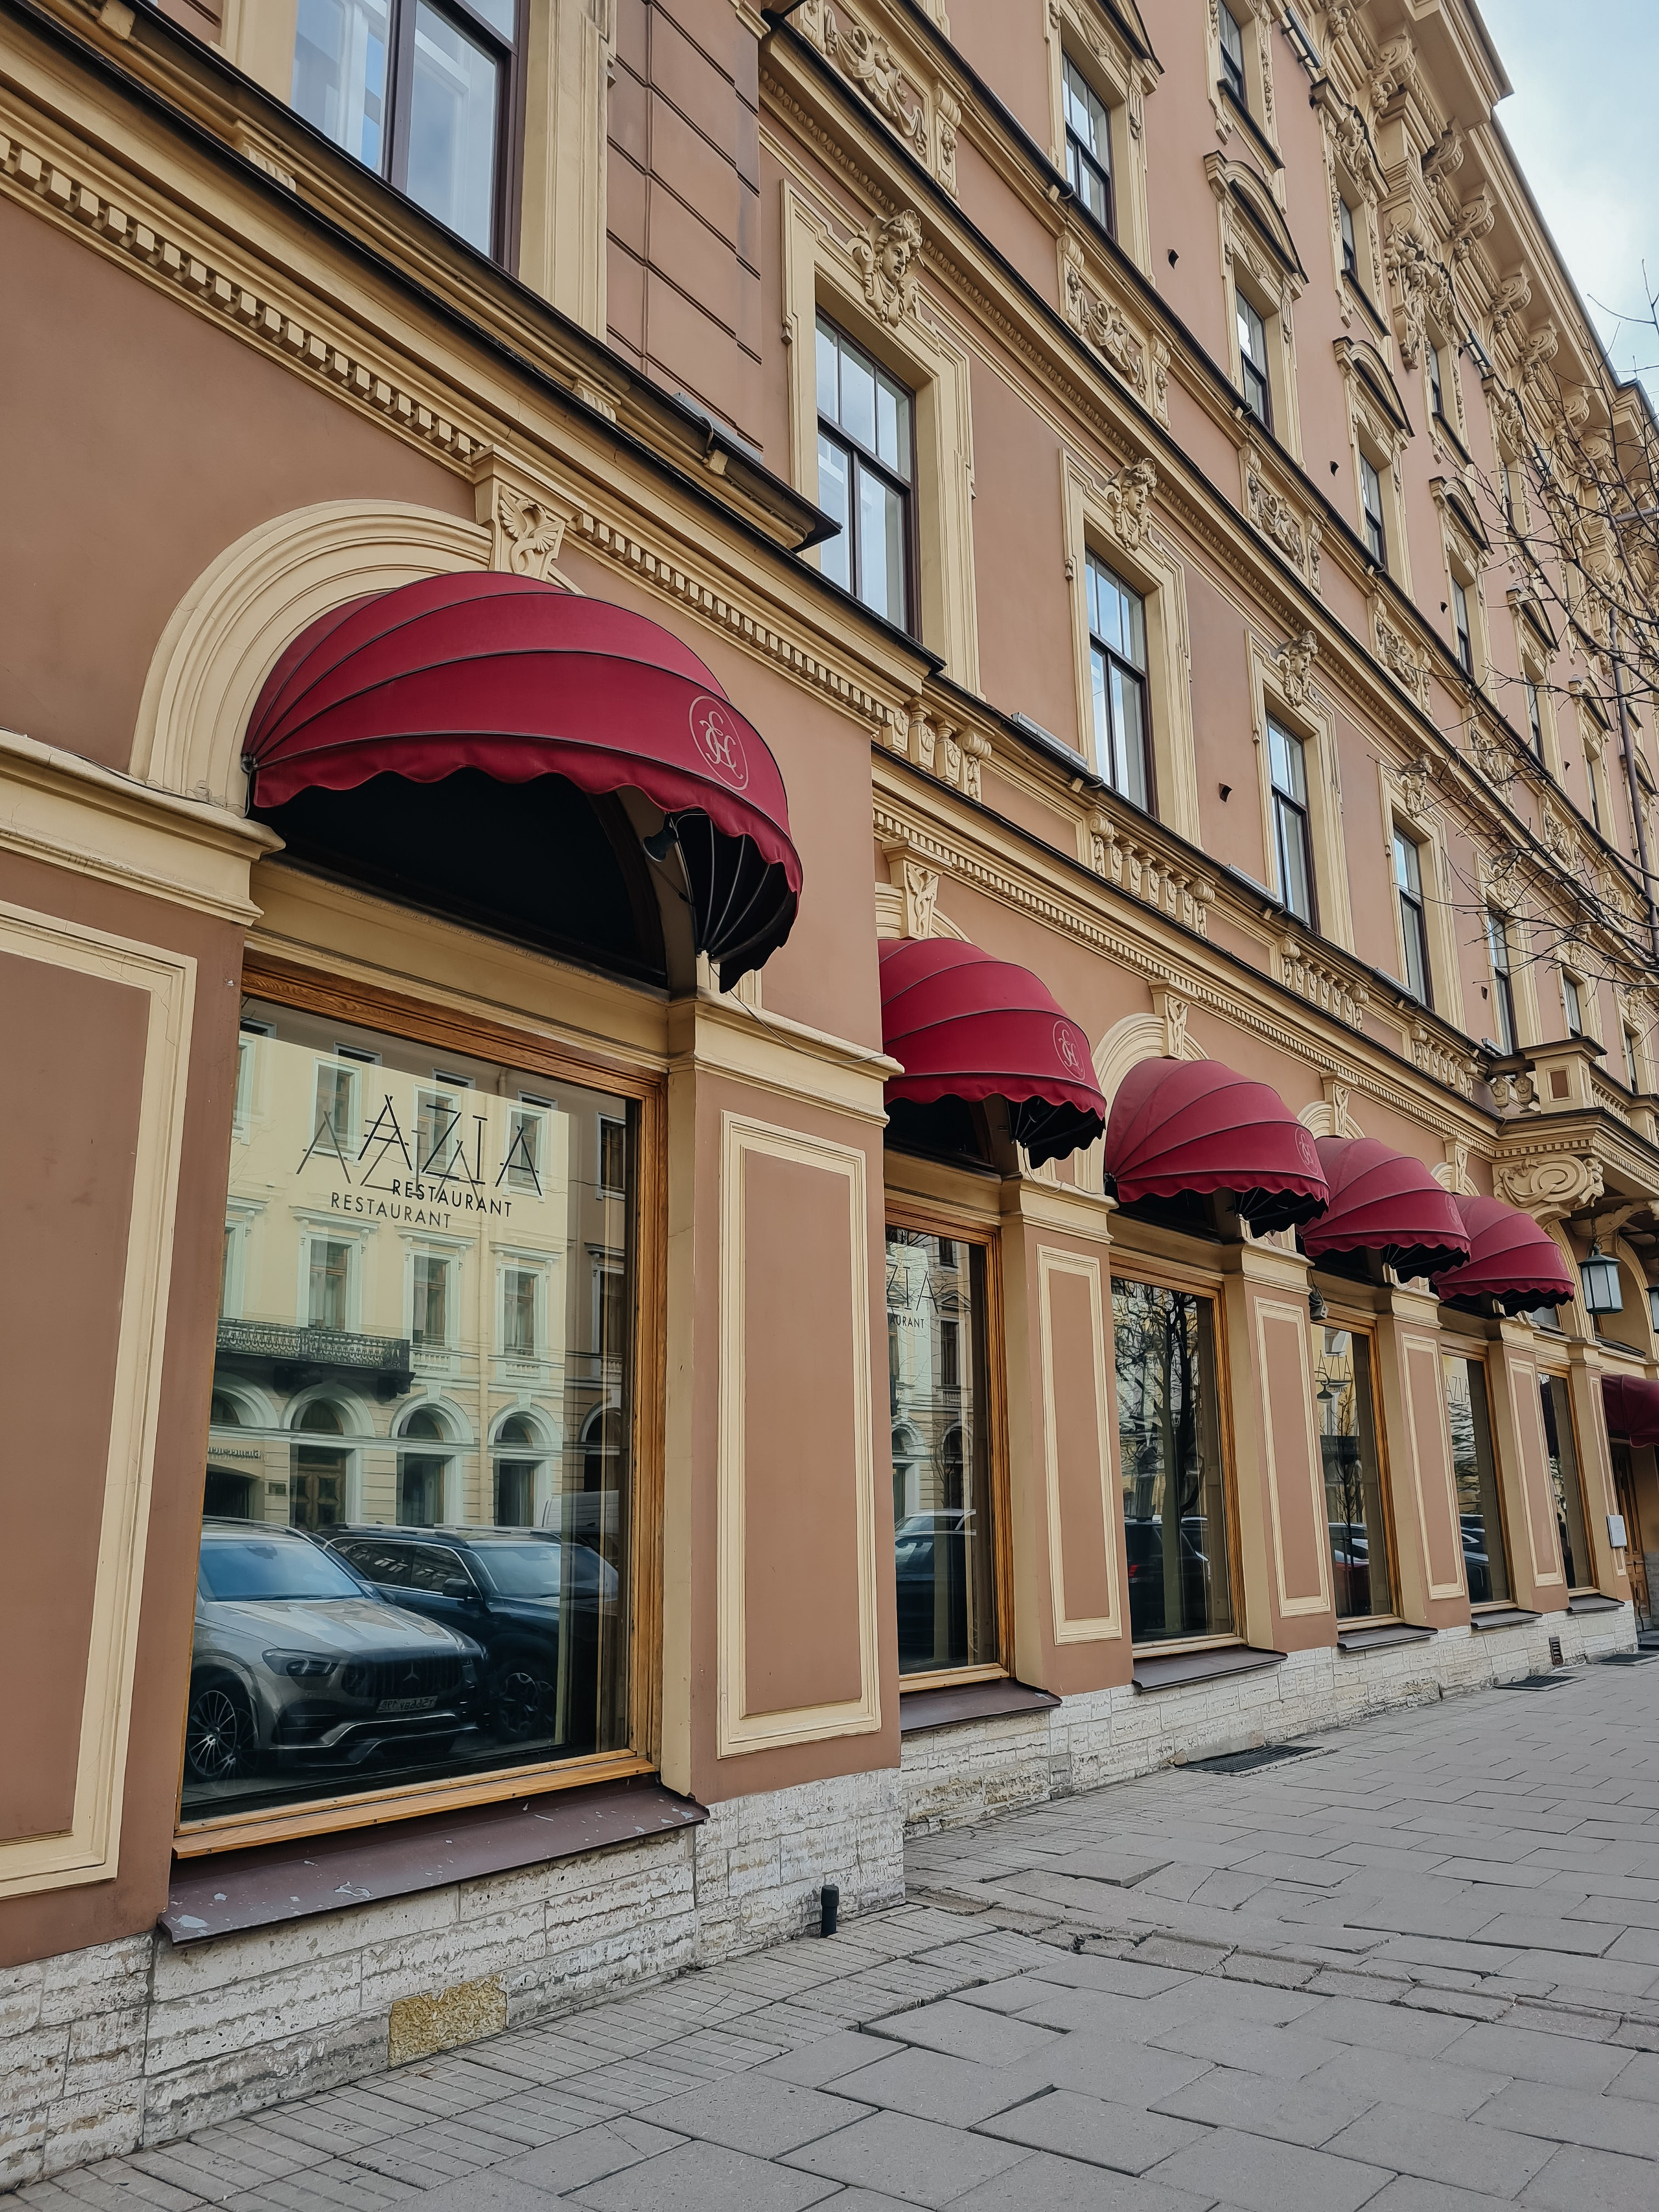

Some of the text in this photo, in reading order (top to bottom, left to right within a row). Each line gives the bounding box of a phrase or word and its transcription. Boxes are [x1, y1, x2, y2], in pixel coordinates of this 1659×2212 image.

[358, 1094, 542, 1196] AZIA
[331, 1192, 451, 1229] RESTAURANT
[392, 1179, 512, 1217] RESTAURANT
